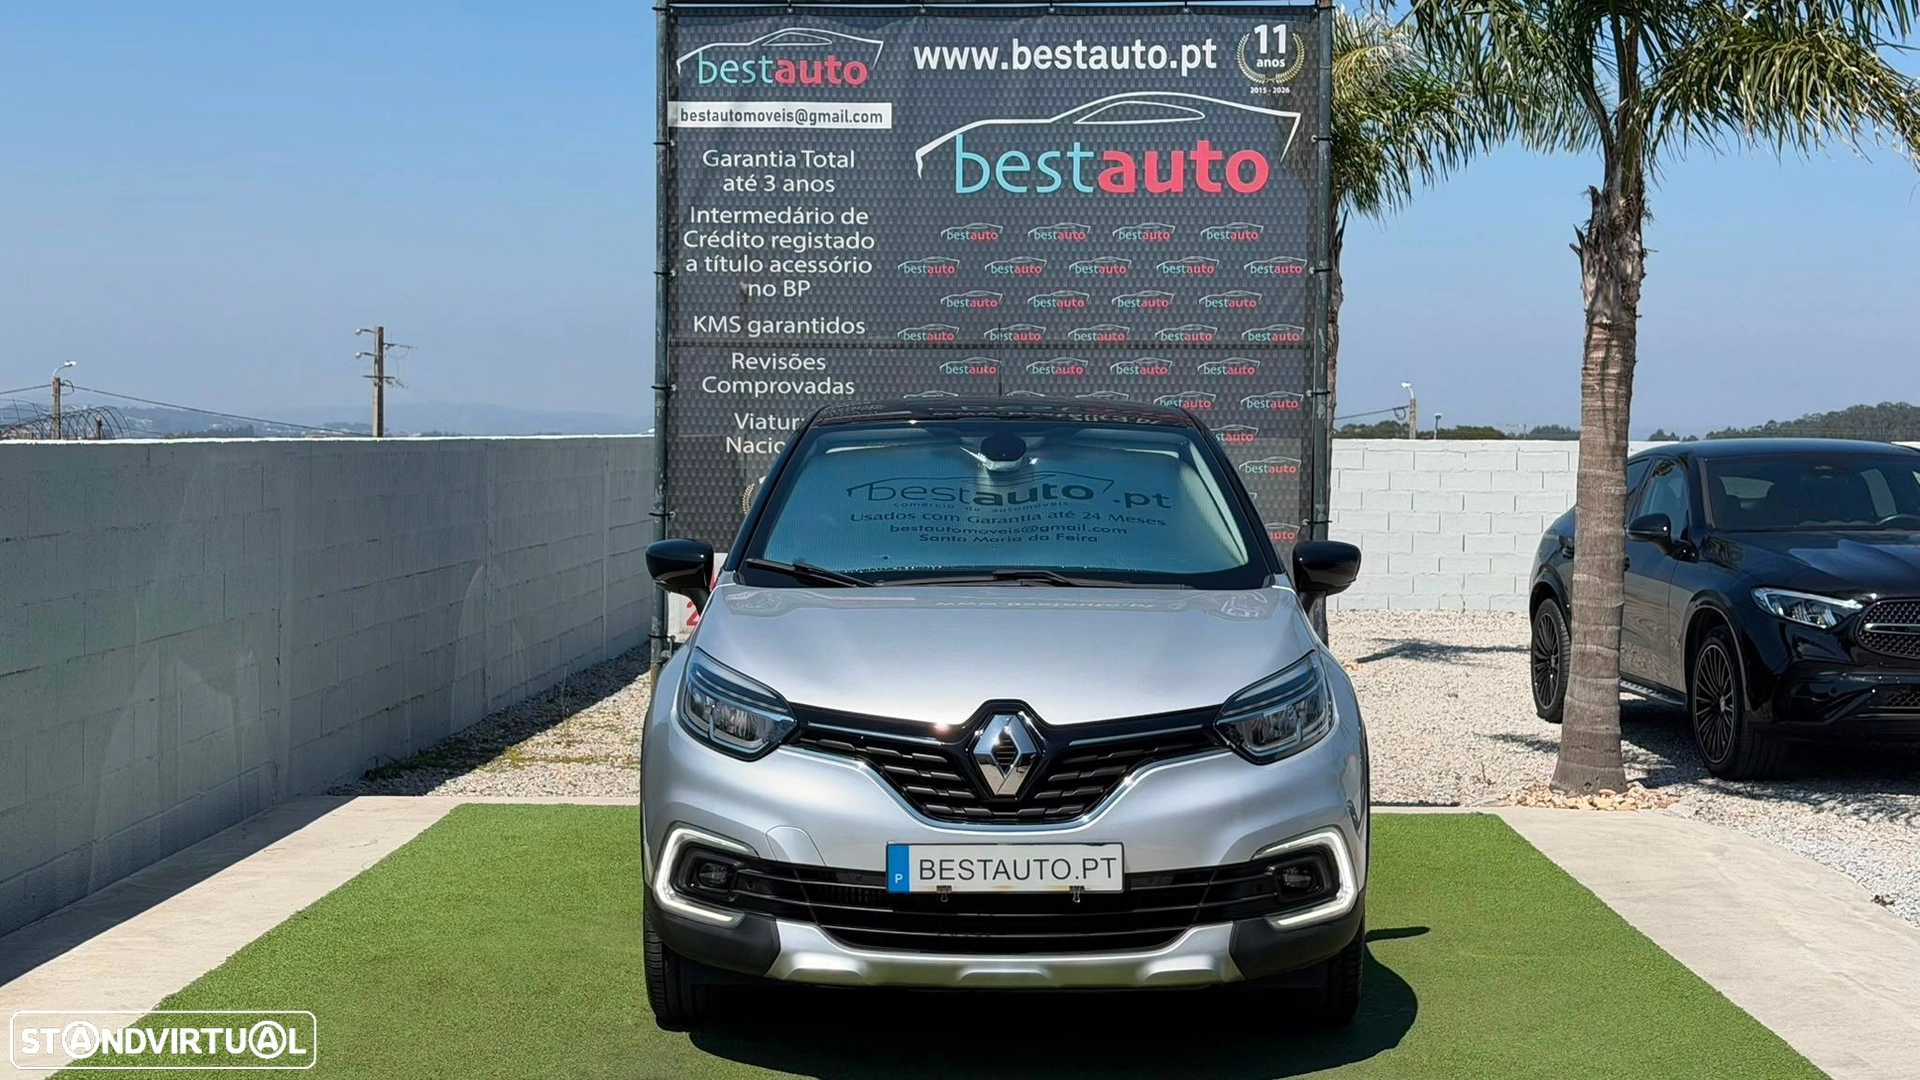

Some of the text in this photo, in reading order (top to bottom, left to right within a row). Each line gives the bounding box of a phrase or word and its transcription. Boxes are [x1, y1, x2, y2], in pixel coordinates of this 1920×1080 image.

[1254, 24, 1286, 54] 11
[914, 38, 1217, 76] www.bestauto.pt
[698, 50, 868, 86] bestauto
[1256, 58, 1286, 68] anos
[680, 108, 883, 126] bestautomoveis@gmail.com
[702, 150, 855, 168] Garantia Total
[955, 133, 1270, 194] bestauto
[723, 174, 835, 192] até 3 anos
[690, 206, 869, 225] Intermedário de
[946, 230, 998, 240] bestauto
[1034, 230, 1086, 240] bestauto
[1118, 230, 1170, 240] bestauto
[1206, 230, 1259, 240] bestauto
[683, 230, 875, 253] Crédito registado
[685, 255, 872, 274] a título acessório
[904, 264, 955, 274] bestauto
[990, 264, 1042, 274] bestauto
[1075, 264, 1126, 274] bestauto
[1162, 264, 1215, 274] bestauto
[1250, 264, 1302, 274] bestauto
[748, 280, 810, 297] no BP
[946, 298, 998, 308] bestauto
[1033, 298, 1084, 308] bestauto
[1118, 298, 1170, 308] bestauto
[1205, 298, 1257, 308] bestauto
[693, 315, 866, 337] KMS garantidos
[903, 331, 954, 342] bestauto
[1074, 331, 1125, 342] bestauto
[1161, 331, 1213, 342] bestauto
[1248, 331, 1300, 342] bestauto
[732, 352, 826, 370] Revisões
[946, 364, 996, 374] bestauto
[1032, 364, 1083, 374] bestauto
[1116, 364, 1168, 374] bestauto
[1203, 364, 1255, 374] bestauto
[702, 376, 855, 398] Comprovadas
[1247, 398, 1298, 408] bestauto
[734, 412, 805, 430] Viatur
[1216, 432, 1254, 442] stauto
[726, 436, 786, 454] Nacio
[1245, 463, 1296, 474] bestauto
[868, 483, 1094, 506] bestauto
[851, 510, 1166, 526] Usados com Garantia até 24 Meses
[890, 524, 1127, 534] bestautomoveis@gmail.com
[919, 534, 966, 542] Santa
[973, 535, 1022, 543] Maria
[1056, 533, 1097, 542] Feira
[895, 858, 1117, 884] P BESTAUTO.PT
